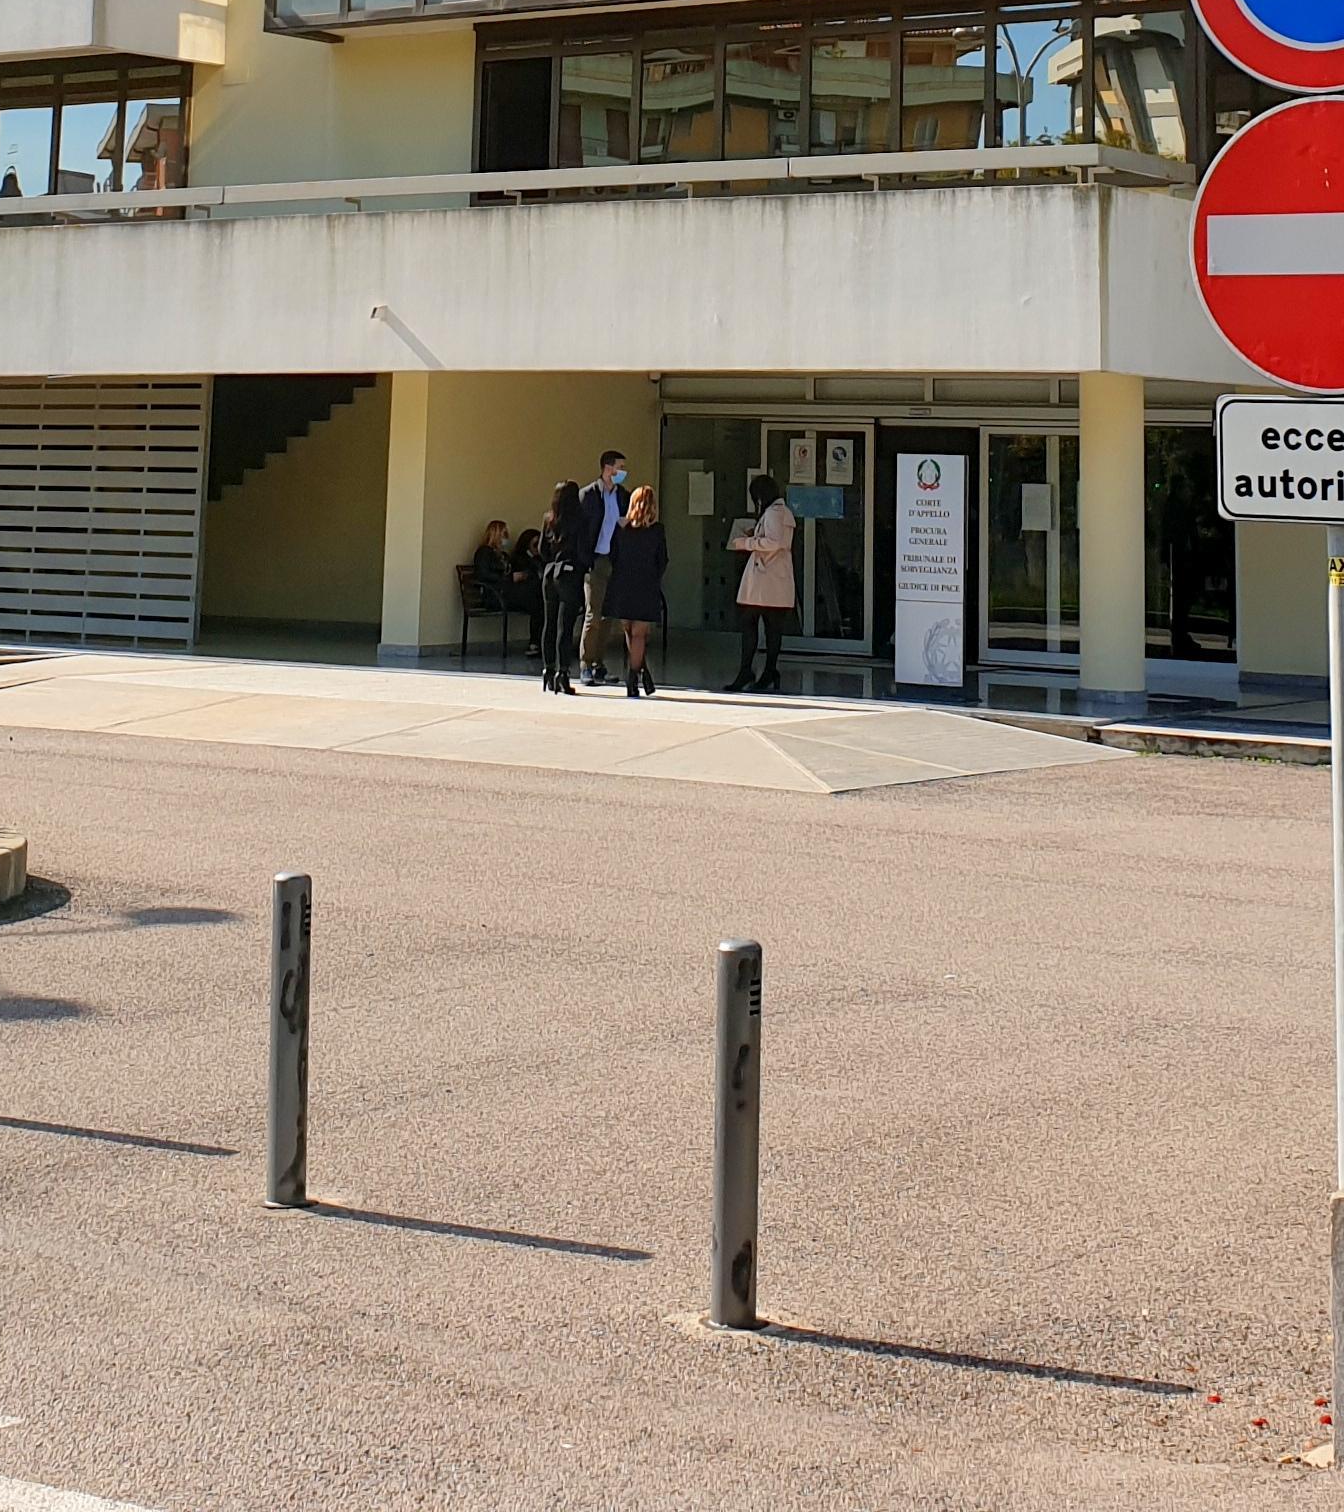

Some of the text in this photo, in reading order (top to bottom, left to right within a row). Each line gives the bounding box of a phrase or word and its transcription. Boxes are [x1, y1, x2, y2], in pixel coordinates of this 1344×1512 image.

[915, 499, 941, 507] CORTE
[908, 509, 950, 518] D'APPELLO
[910, 526, 947, 535] PROCURA
[908, 537, 948, 546] GENERALE
[903, 554, 943, 563] TRIBUNALE
[900, 565, 958, 575] SORVEGLIANZA
[898, 582, 928, 591] GIUDICE
[941, 584, 961, 593] PACE
